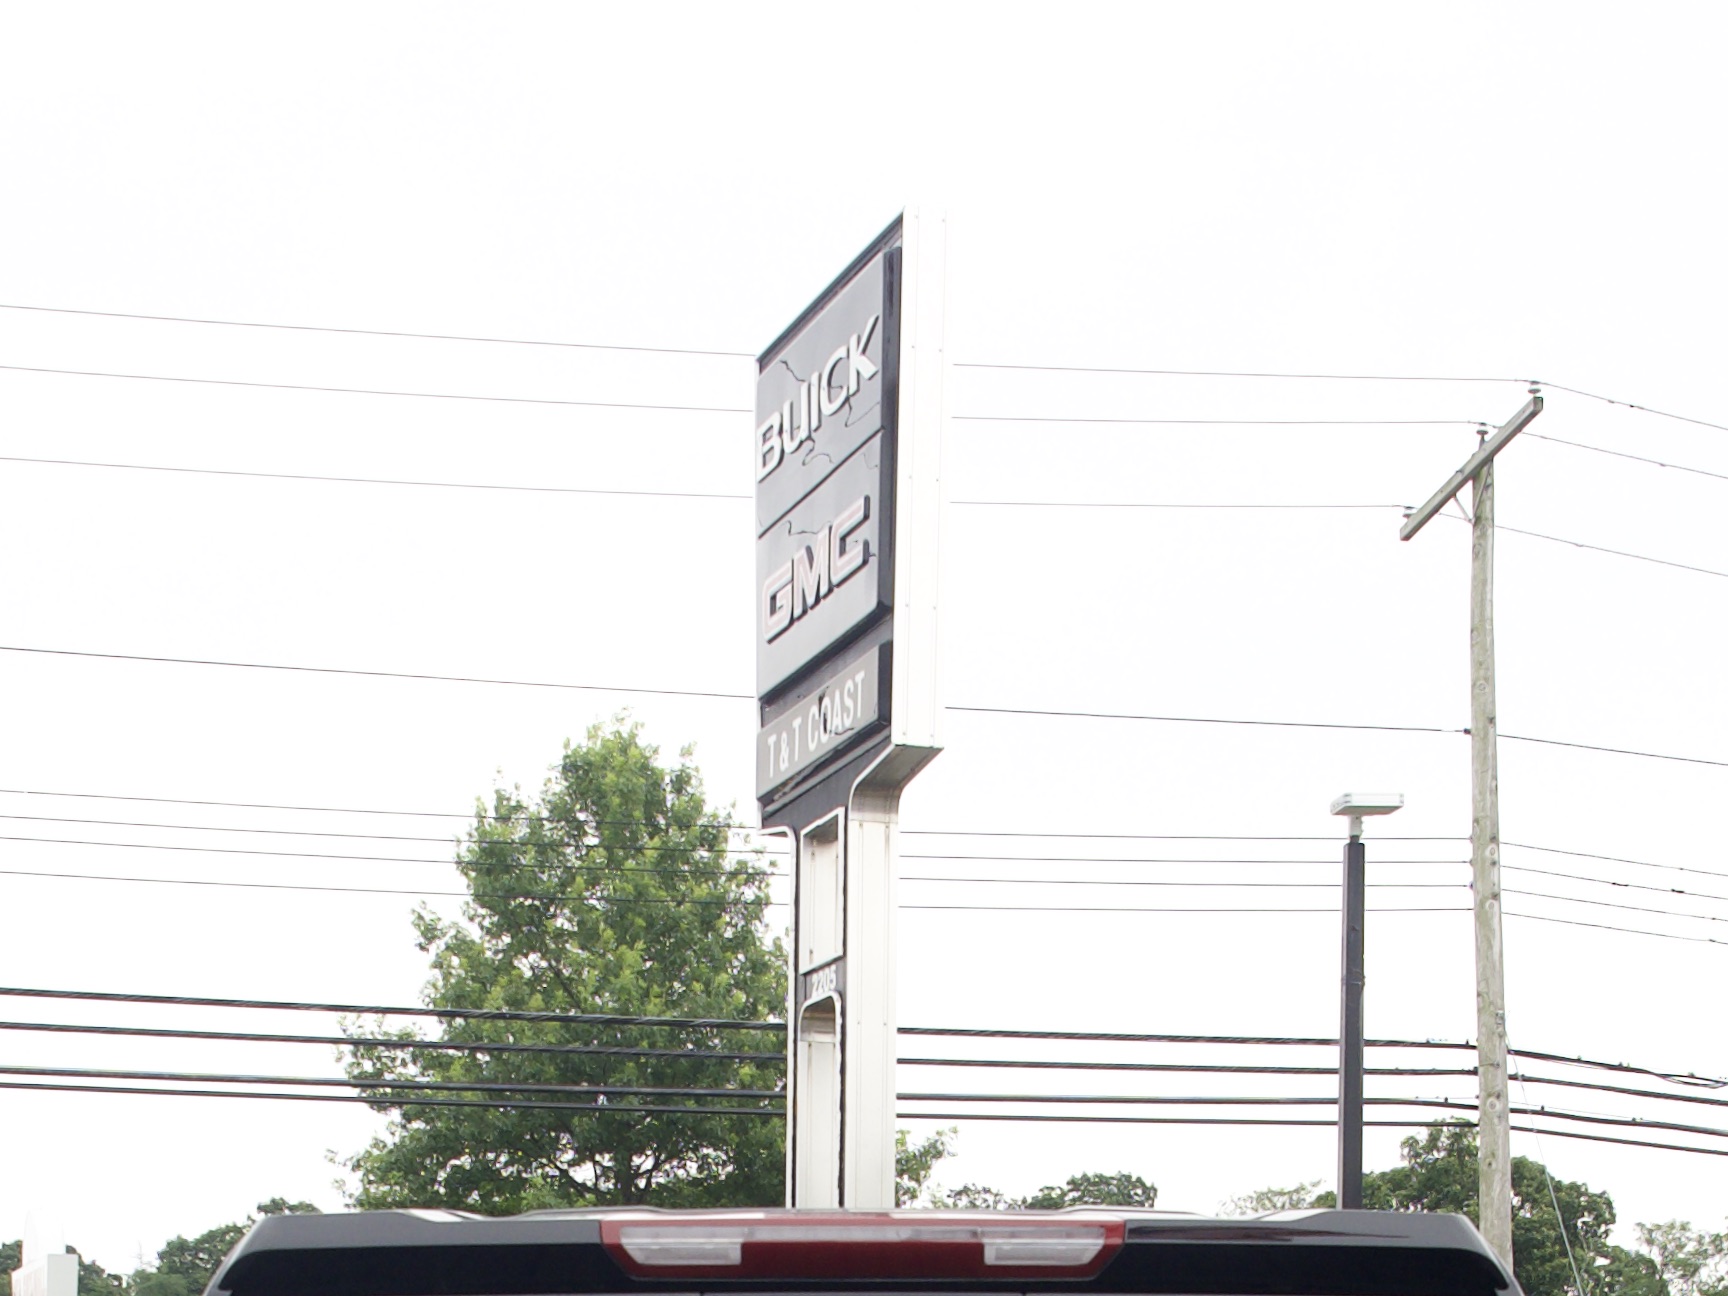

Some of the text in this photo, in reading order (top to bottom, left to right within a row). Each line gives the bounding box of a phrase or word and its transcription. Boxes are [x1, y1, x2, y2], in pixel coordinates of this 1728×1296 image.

[757, 315, 879, 482] BUICK
[762, 495, 870, 644] GMC
[808, 671, 865, 751] COAST
